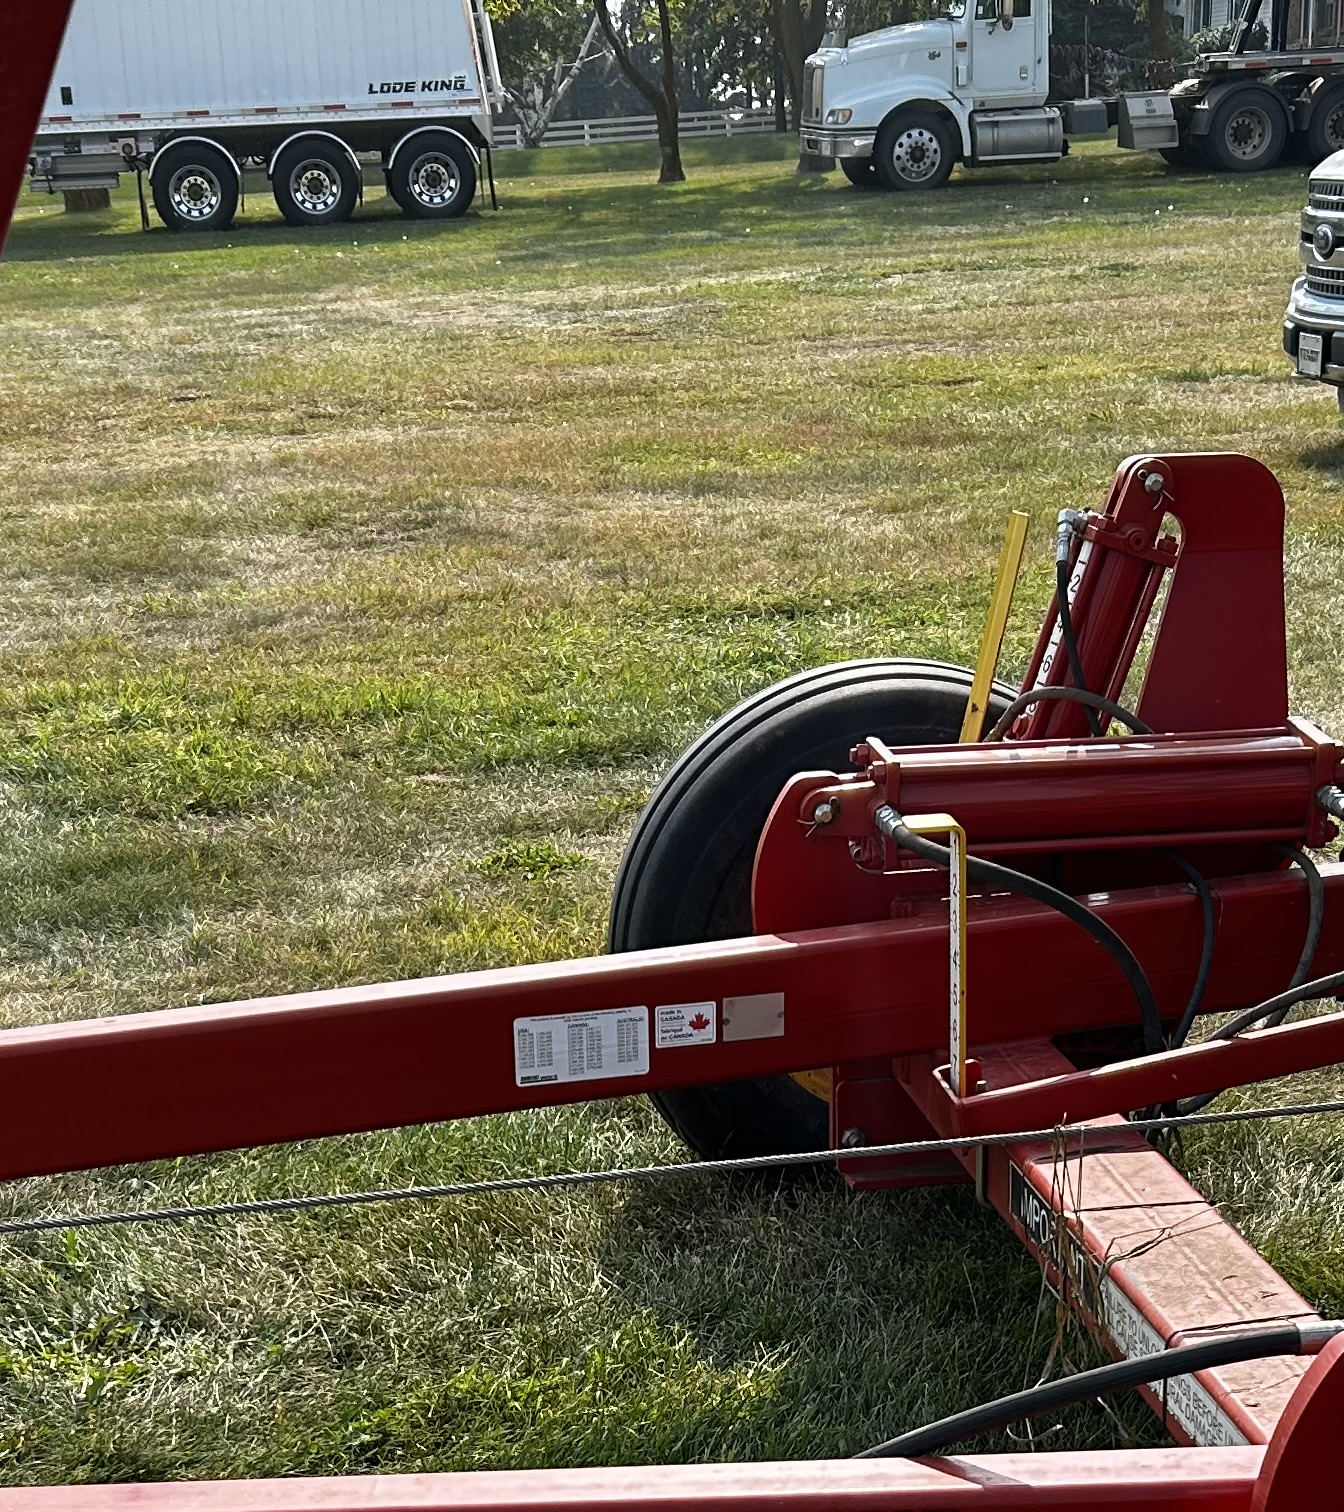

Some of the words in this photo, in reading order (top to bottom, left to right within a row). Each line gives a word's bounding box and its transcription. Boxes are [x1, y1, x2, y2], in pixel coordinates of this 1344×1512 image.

[368, 81, 416, 94] LODE
[421, 79, 466, 91] KING
[1070, 574, 1080, 593] 2
[1042, 654, 1052, 673] 6
[1192, 1391, 1224, 1442] BEFORE
